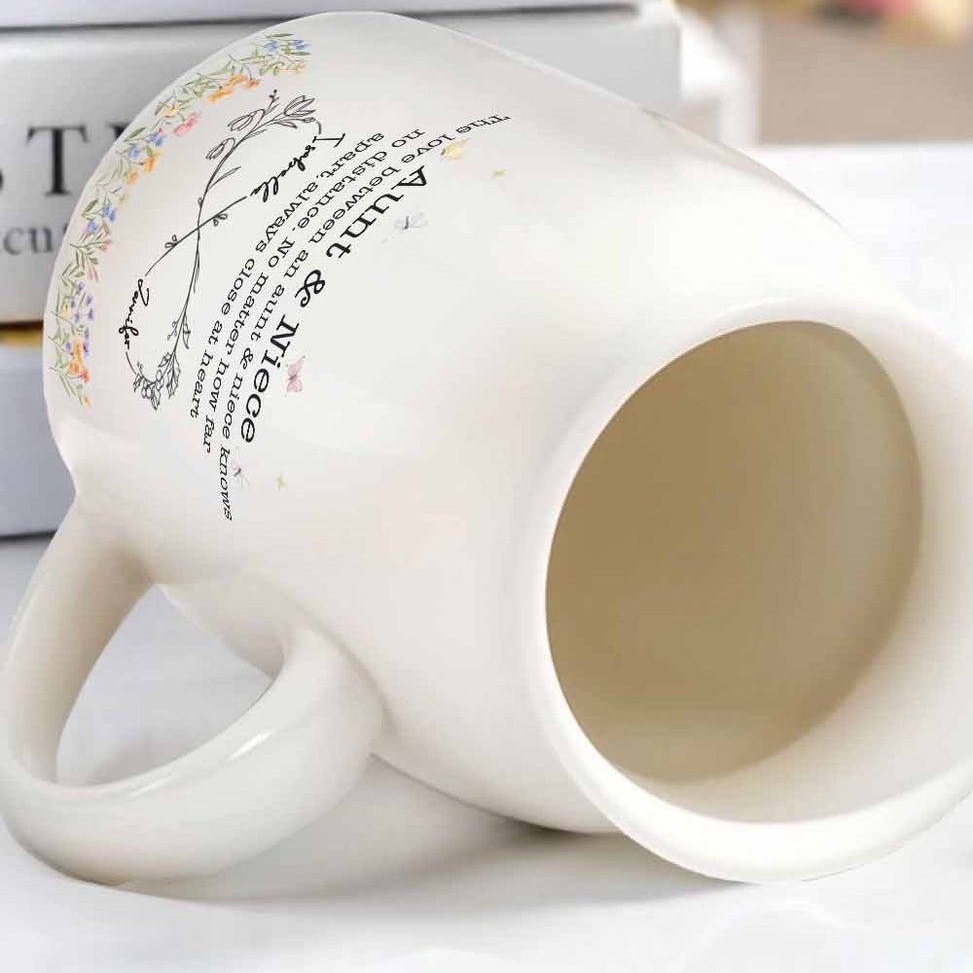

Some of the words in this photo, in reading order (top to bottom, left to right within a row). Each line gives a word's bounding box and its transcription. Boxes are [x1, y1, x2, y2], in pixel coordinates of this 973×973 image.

[391, 128, 426, 148] no
[401, 134, 456, 164] love
[456, 114, 511, 134] The
[249, 132, 346, 203] Isabella
[315, 133, 385, 179] apart,
[255, 181, 319, 253] always
[292, 151, 388, 231] distance.
[308, 166, 401, 244] between
[339, 165, 427, 259] Aunt
[267, 236, 296, 268] No
[283, 249, 309, 278] an
[117, 278, 150, 350] Jennifer
[221, 258, 255, 316] close
[225, 271, 269, 356] matter
[250, 284, 285, 342] aunt
[294, 269, 326, 308] &
[208, 320, 223, 345] at
[239, 347, 254, 370] &
[190, 349, 214, 418] heart
[208, 358, 230, 413] how
[222, 373, 243, 440] niece
[240, 314, 300, 443] Niece
[202, 414, 215, 454] far
[219, 446, 233, 521] knows
